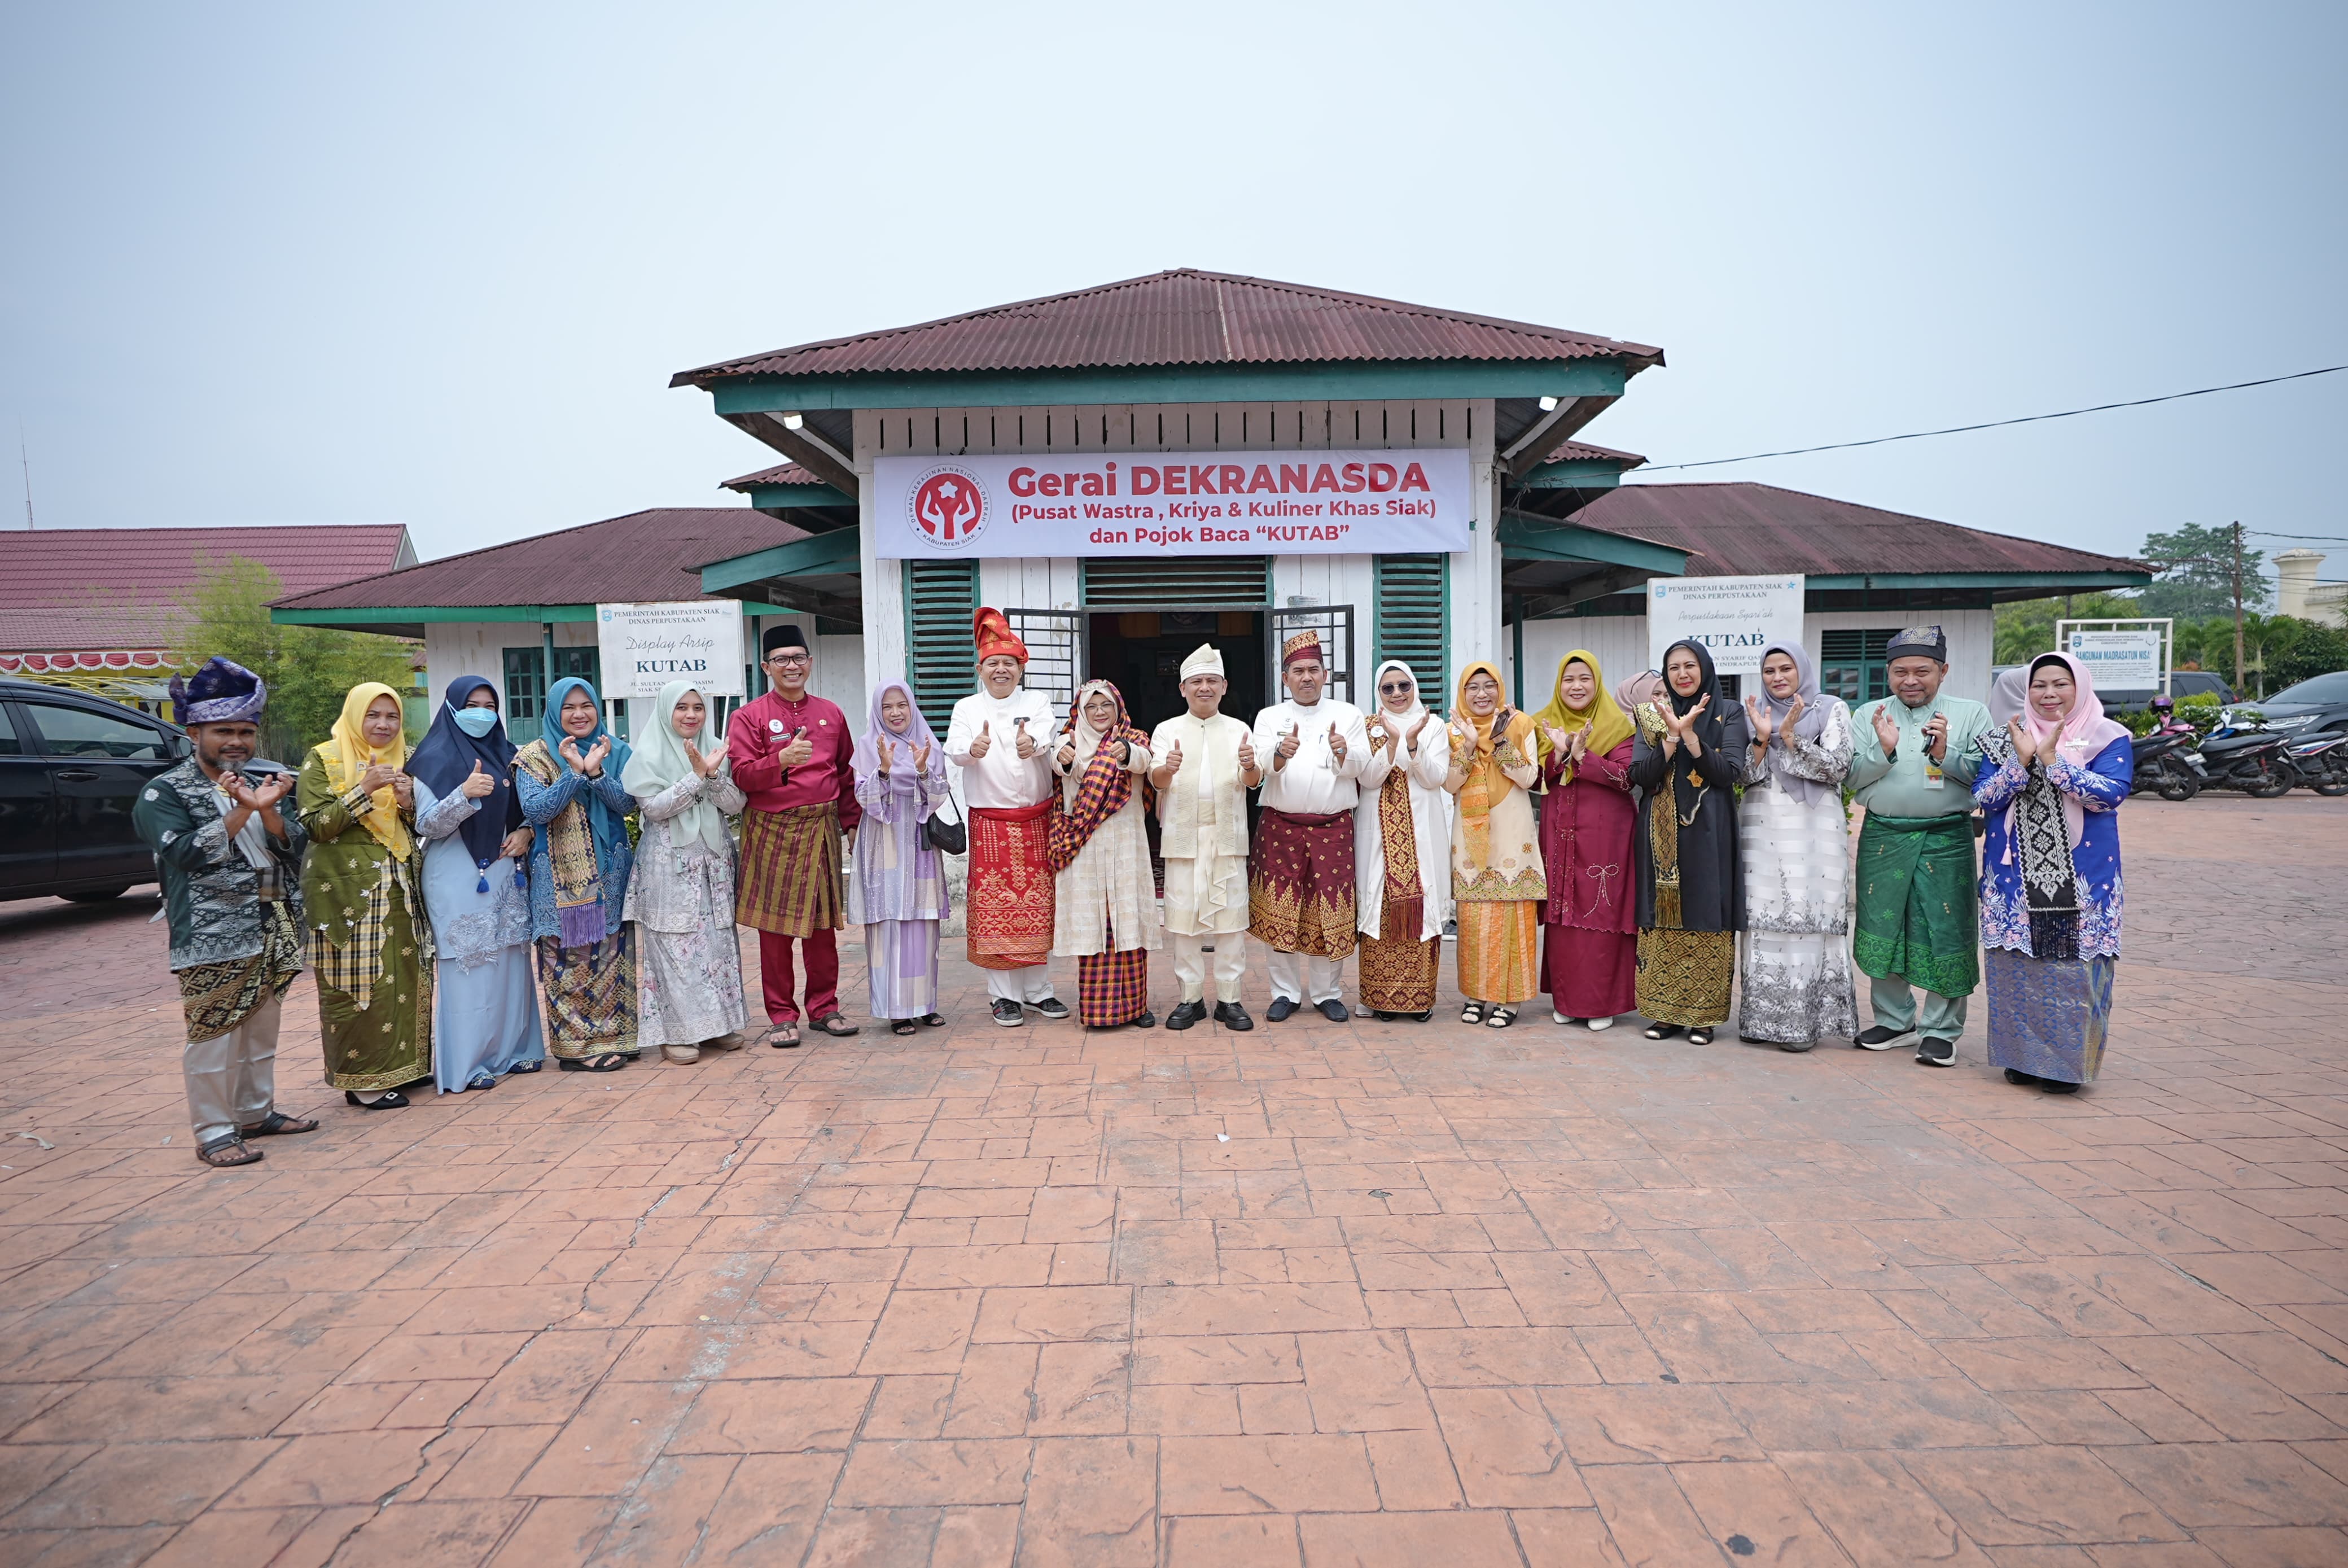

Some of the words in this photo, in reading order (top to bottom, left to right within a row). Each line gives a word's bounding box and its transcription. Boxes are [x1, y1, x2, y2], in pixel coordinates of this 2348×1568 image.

[912, 467, 947, 495] KERAJINAN
[949, 467, 982, 489] NASIONAL
[1008, 462, 1117, 497] Gerai
[1131, 462, 1431, 496] DEKRANASDA
[1012, 504, 1077, 523] (Pusat
[1083, 503, 1153, 519] Wastra
[1169, 501, 1221, 521] Kriya
[1228, 502, 1242, 517] &
[1249, 500, 1322, 516] Kuliner
[1329, 500, 1379, 516] Khas
[1386, 498, 1436, 519] Siak)
[922, 534, 960, 546] KABUPATEN
[961, 533, 976, 545] SIAK
[1089, 528, 1128, 543] dan
[1135, 525, 1193, 546] Pojok
[1201, 527, 1250, 542] Baca
[1678, 610, 1735, 623] Perpustakaan
[626, 635, 676, 654] Display
[679, 634, 715, 652] Arsip
[2103, 650, 2138, 660] MADRASATUN
[636, 659, 707, 673] KUTAB
